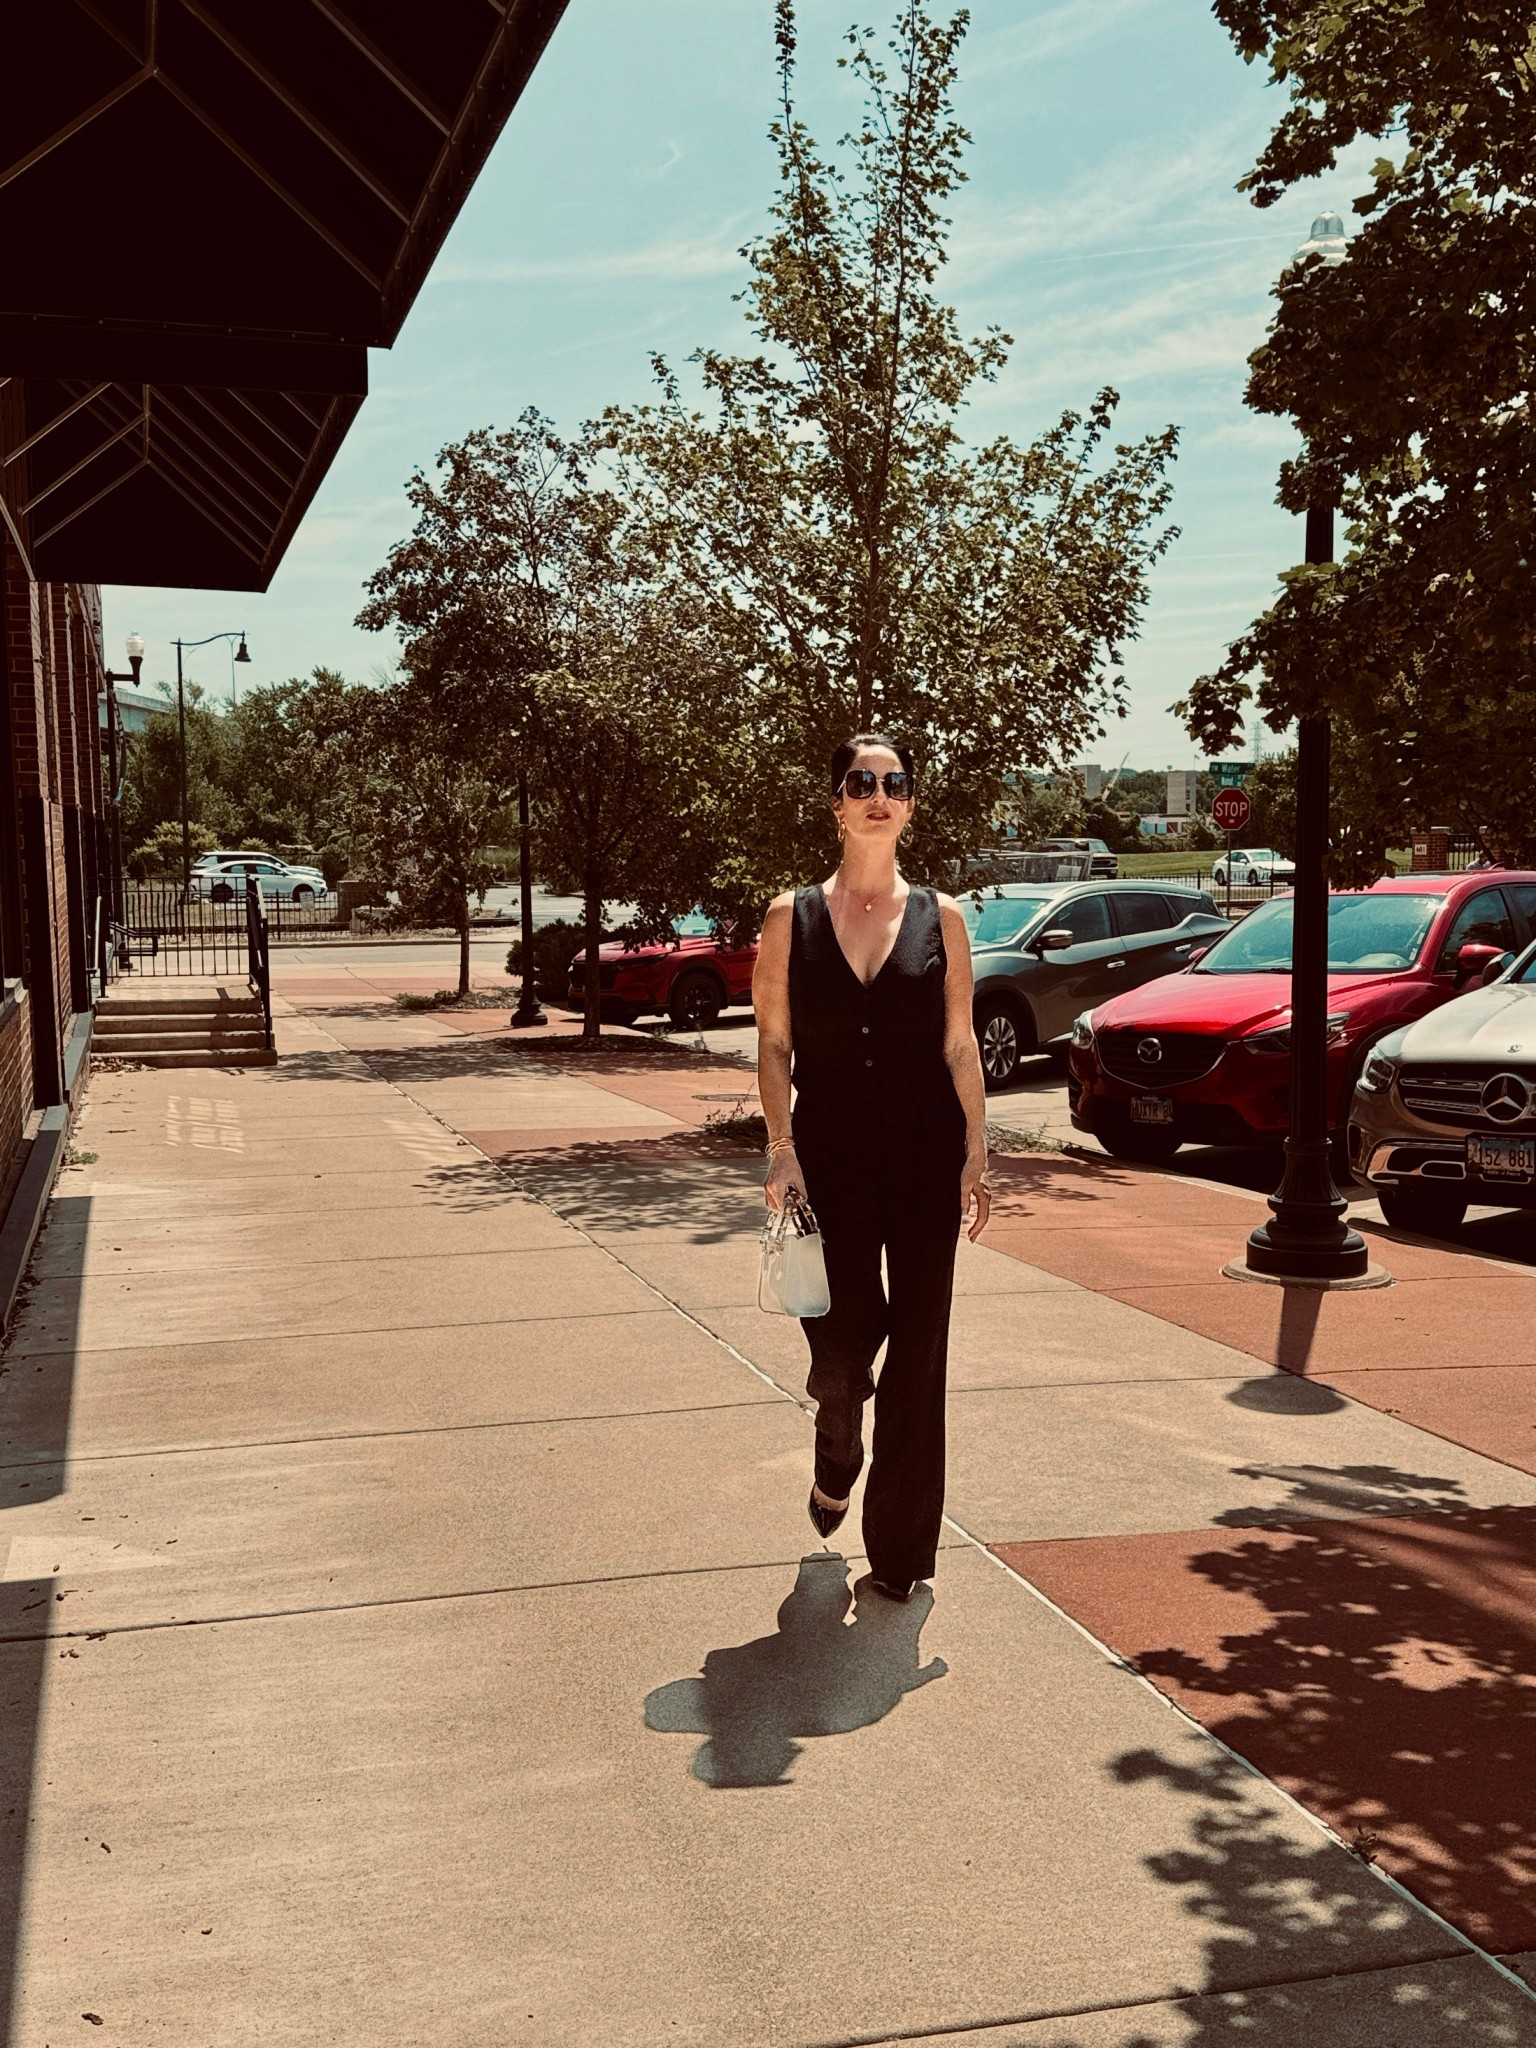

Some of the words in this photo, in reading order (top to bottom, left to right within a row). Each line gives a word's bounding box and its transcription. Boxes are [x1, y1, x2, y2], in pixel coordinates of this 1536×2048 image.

[1221, 764, 1241, 773] Water
[1215, 801, 1248, 817] STOP
[1478, 1148, 1502, 1166] 152
[1509, 1150, 1533, 1168] 881
